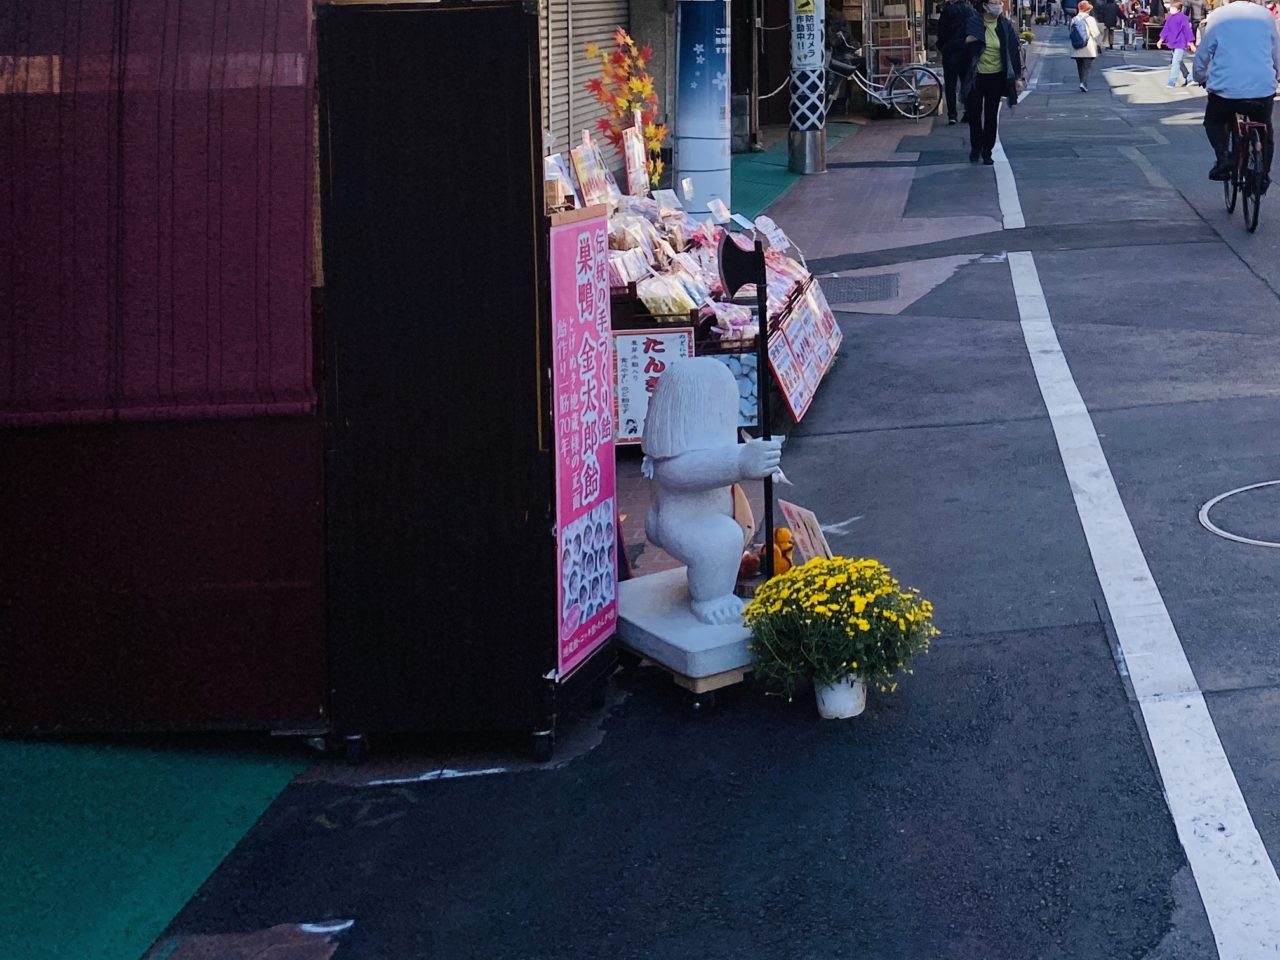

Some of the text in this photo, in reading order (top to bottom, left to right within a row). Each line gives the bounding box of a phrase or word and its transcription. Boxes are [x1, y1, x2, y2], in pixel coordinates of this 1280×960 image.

[805, 14, 816, 58] 防犯カメラ
[577, 237, 599, 501] 巣鴨 金太郎飴
